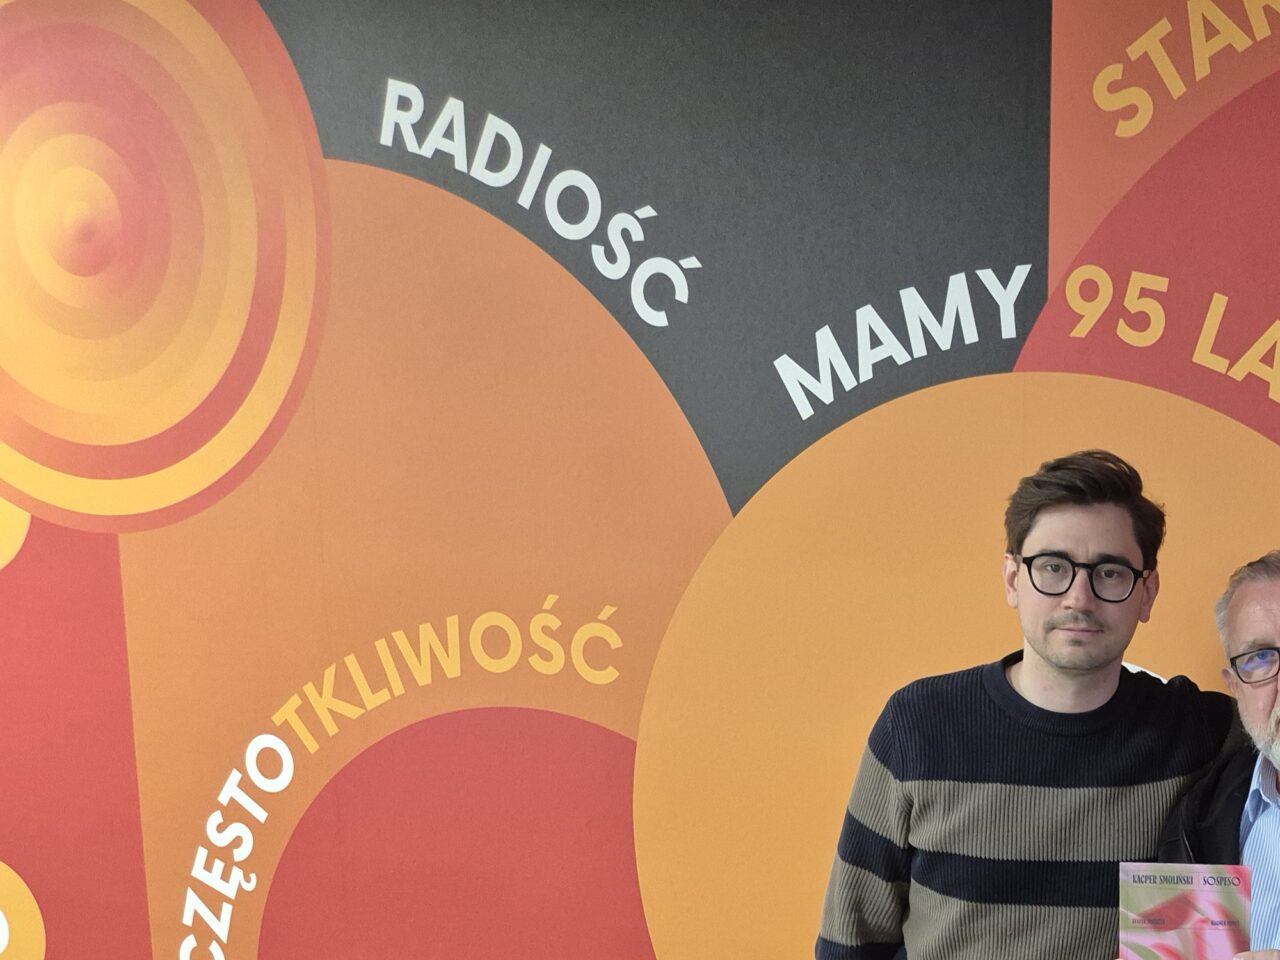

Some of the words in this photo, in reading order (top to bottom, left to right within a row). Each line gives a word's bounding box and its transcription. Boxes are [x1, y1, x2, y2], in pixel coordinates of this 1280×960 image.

[379, 78, 703, 327] RADIOŚĆ
[773, 264, 1033, 421] MAMY
[1065, 264, 1169, 347] 95
[1132, 874, 1157, 885] KACPER
[1159, 873, 1193, 886] SMOLIŃSKI
[1203, 875, 1241, 886] SOSPESO
